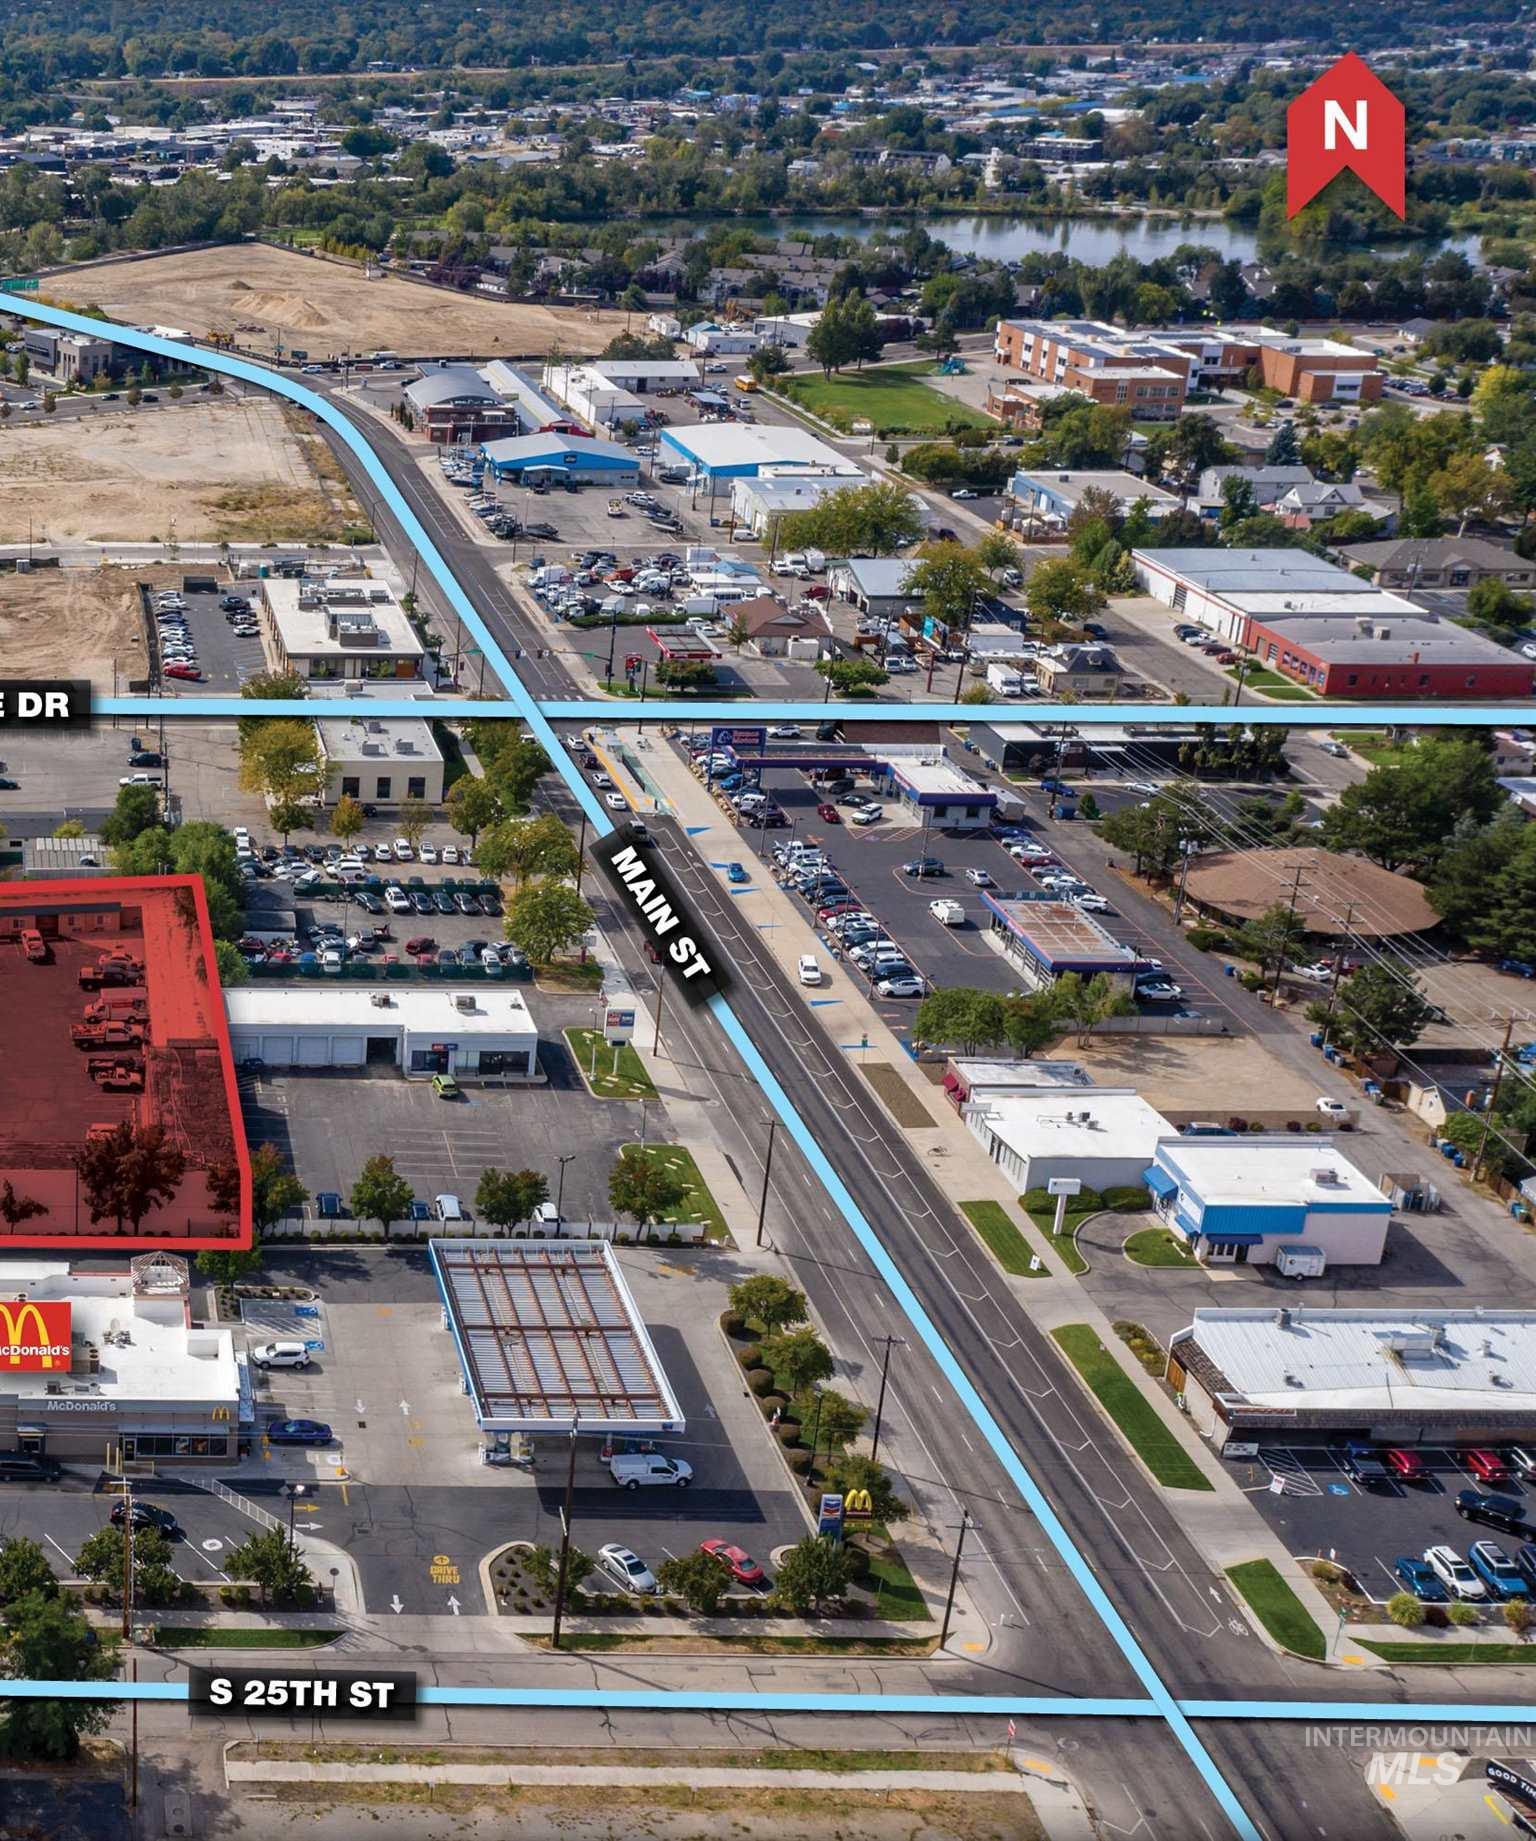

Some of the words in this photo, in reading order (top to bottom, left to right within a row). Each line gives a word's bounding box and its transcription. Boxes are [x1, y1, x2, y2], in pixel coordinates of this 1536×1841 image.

[47, 1401, 117, 1412] McDonald's
[430, 1565, 460, 1575] DRIVE
[433, 1574, 461, 1585] THRU
[1488, 1767, 1518, 1784] GOOD
